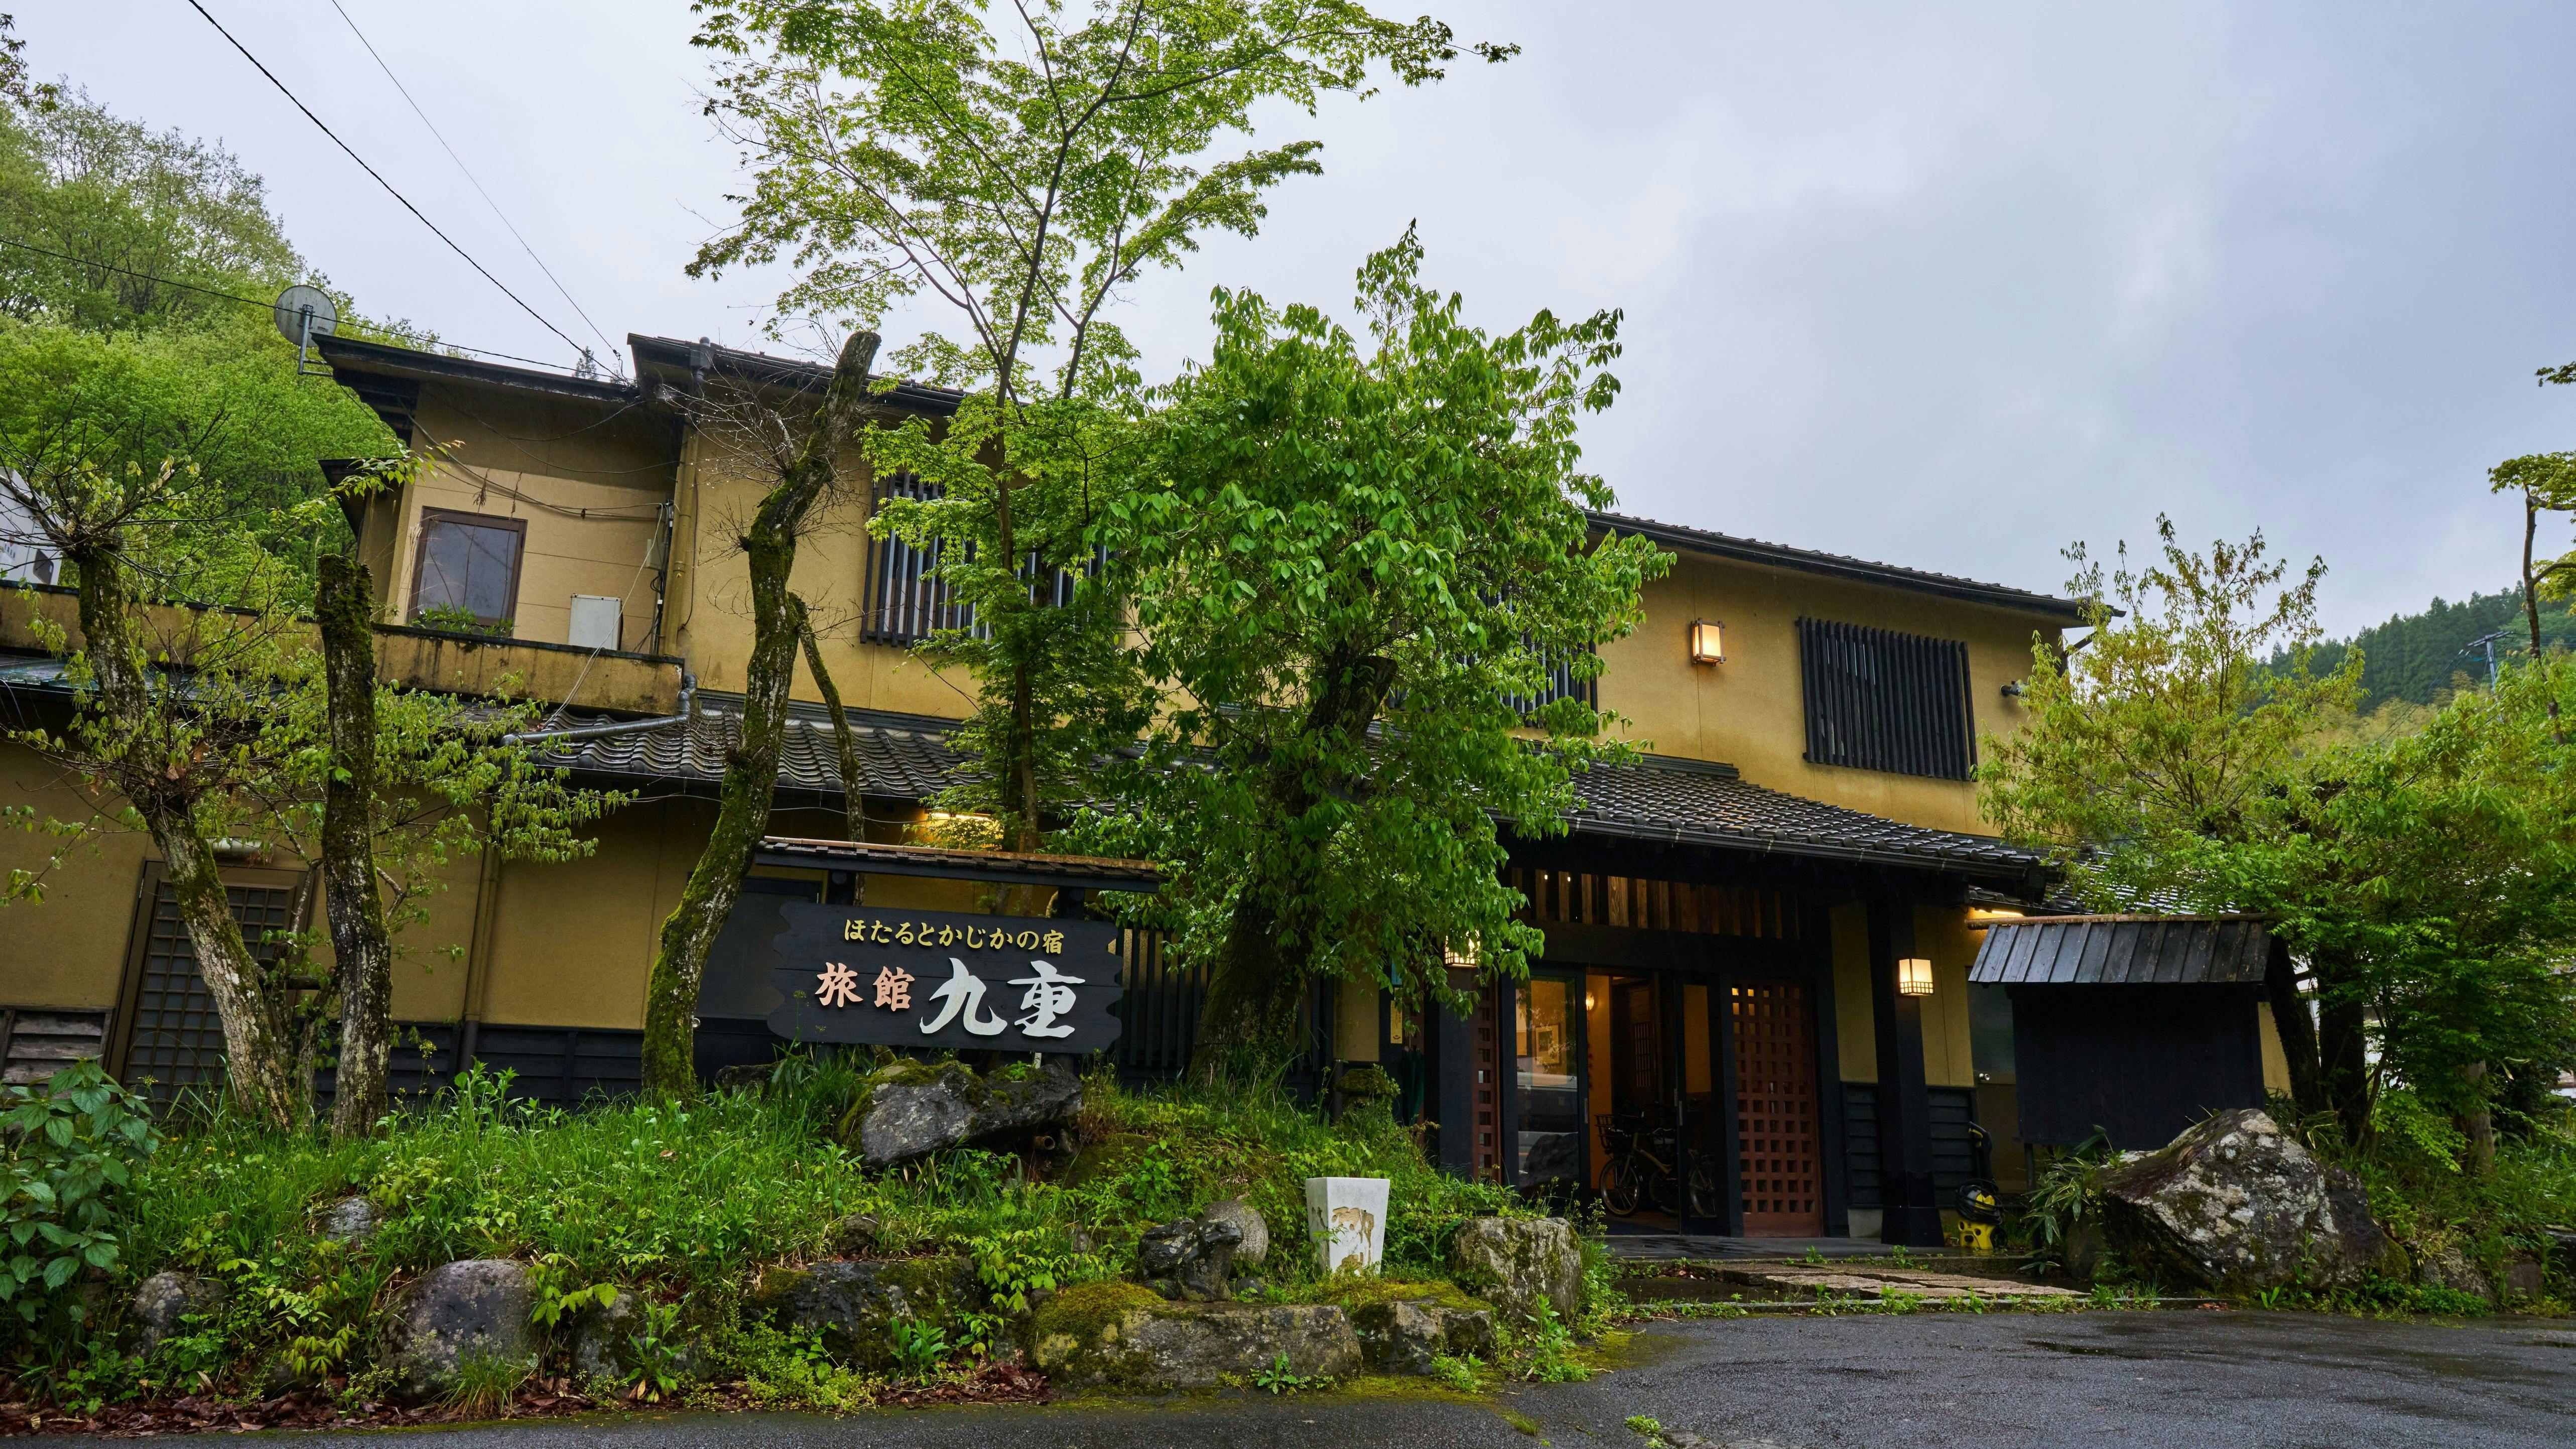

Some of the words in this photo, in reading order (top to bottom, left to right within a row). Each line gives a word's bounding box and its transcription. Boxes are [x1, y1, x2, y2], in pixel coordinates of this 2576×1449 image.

[844, 918, 1065, 955] ほたるとかじかの宿
